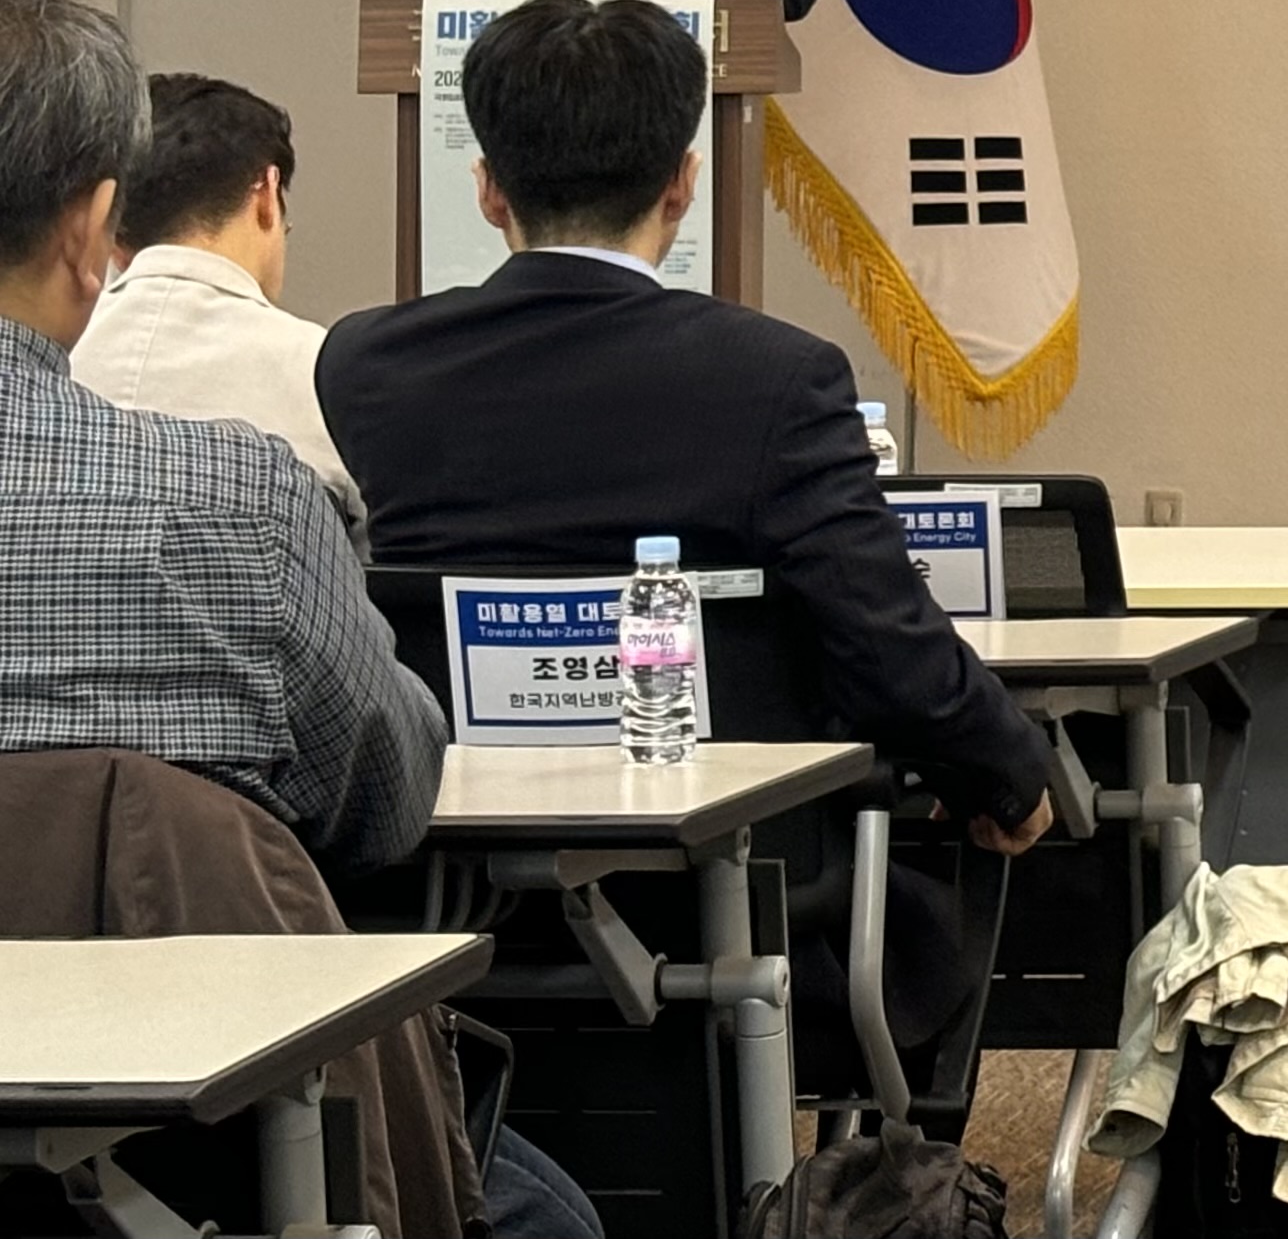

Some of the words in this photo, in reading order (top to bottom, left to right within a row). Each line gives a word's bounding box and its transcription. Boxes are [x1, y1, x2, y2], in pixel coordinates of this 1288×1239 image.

[953, 531, 977, 543] City
[477, 602, 567, 623] 미활용열
[478, 626, 534, 638] Towards
